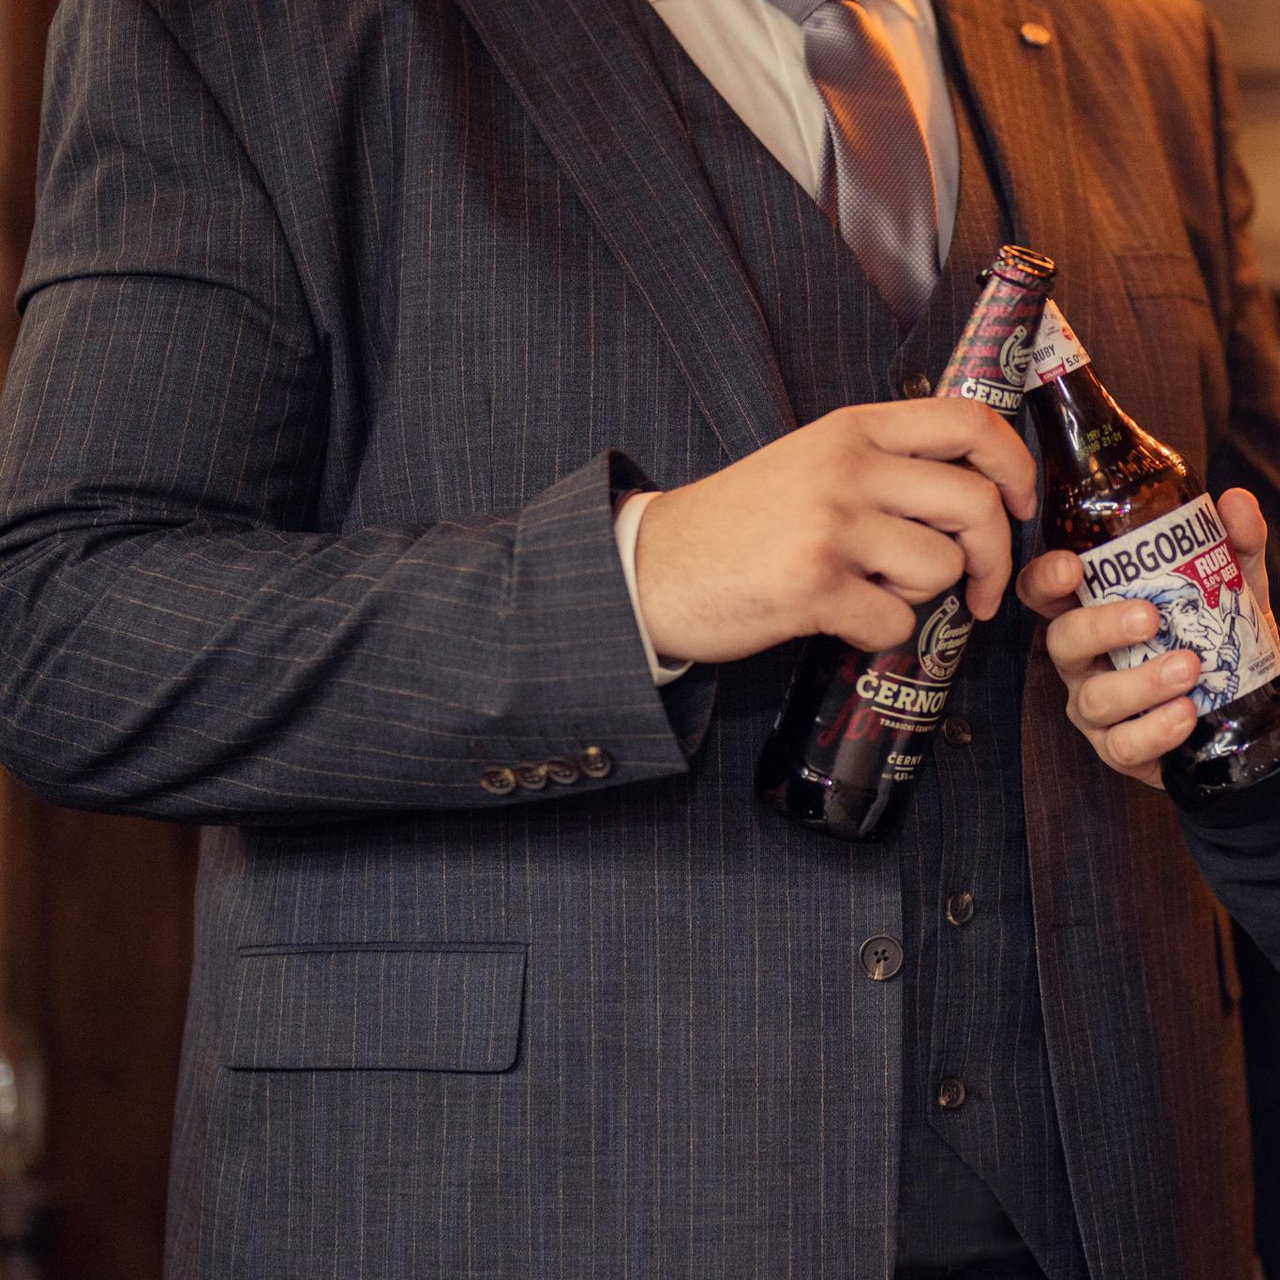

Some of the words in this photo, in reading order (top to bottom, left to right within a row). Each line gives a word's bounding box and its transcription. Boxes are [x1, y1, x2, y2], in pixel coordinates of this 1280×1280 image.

[1032, 344, 1056, 364] RUBY
[1084, 503, 1222, 598] HOBGOBLIN
[1194, 543, 1231, 579] RUBY
